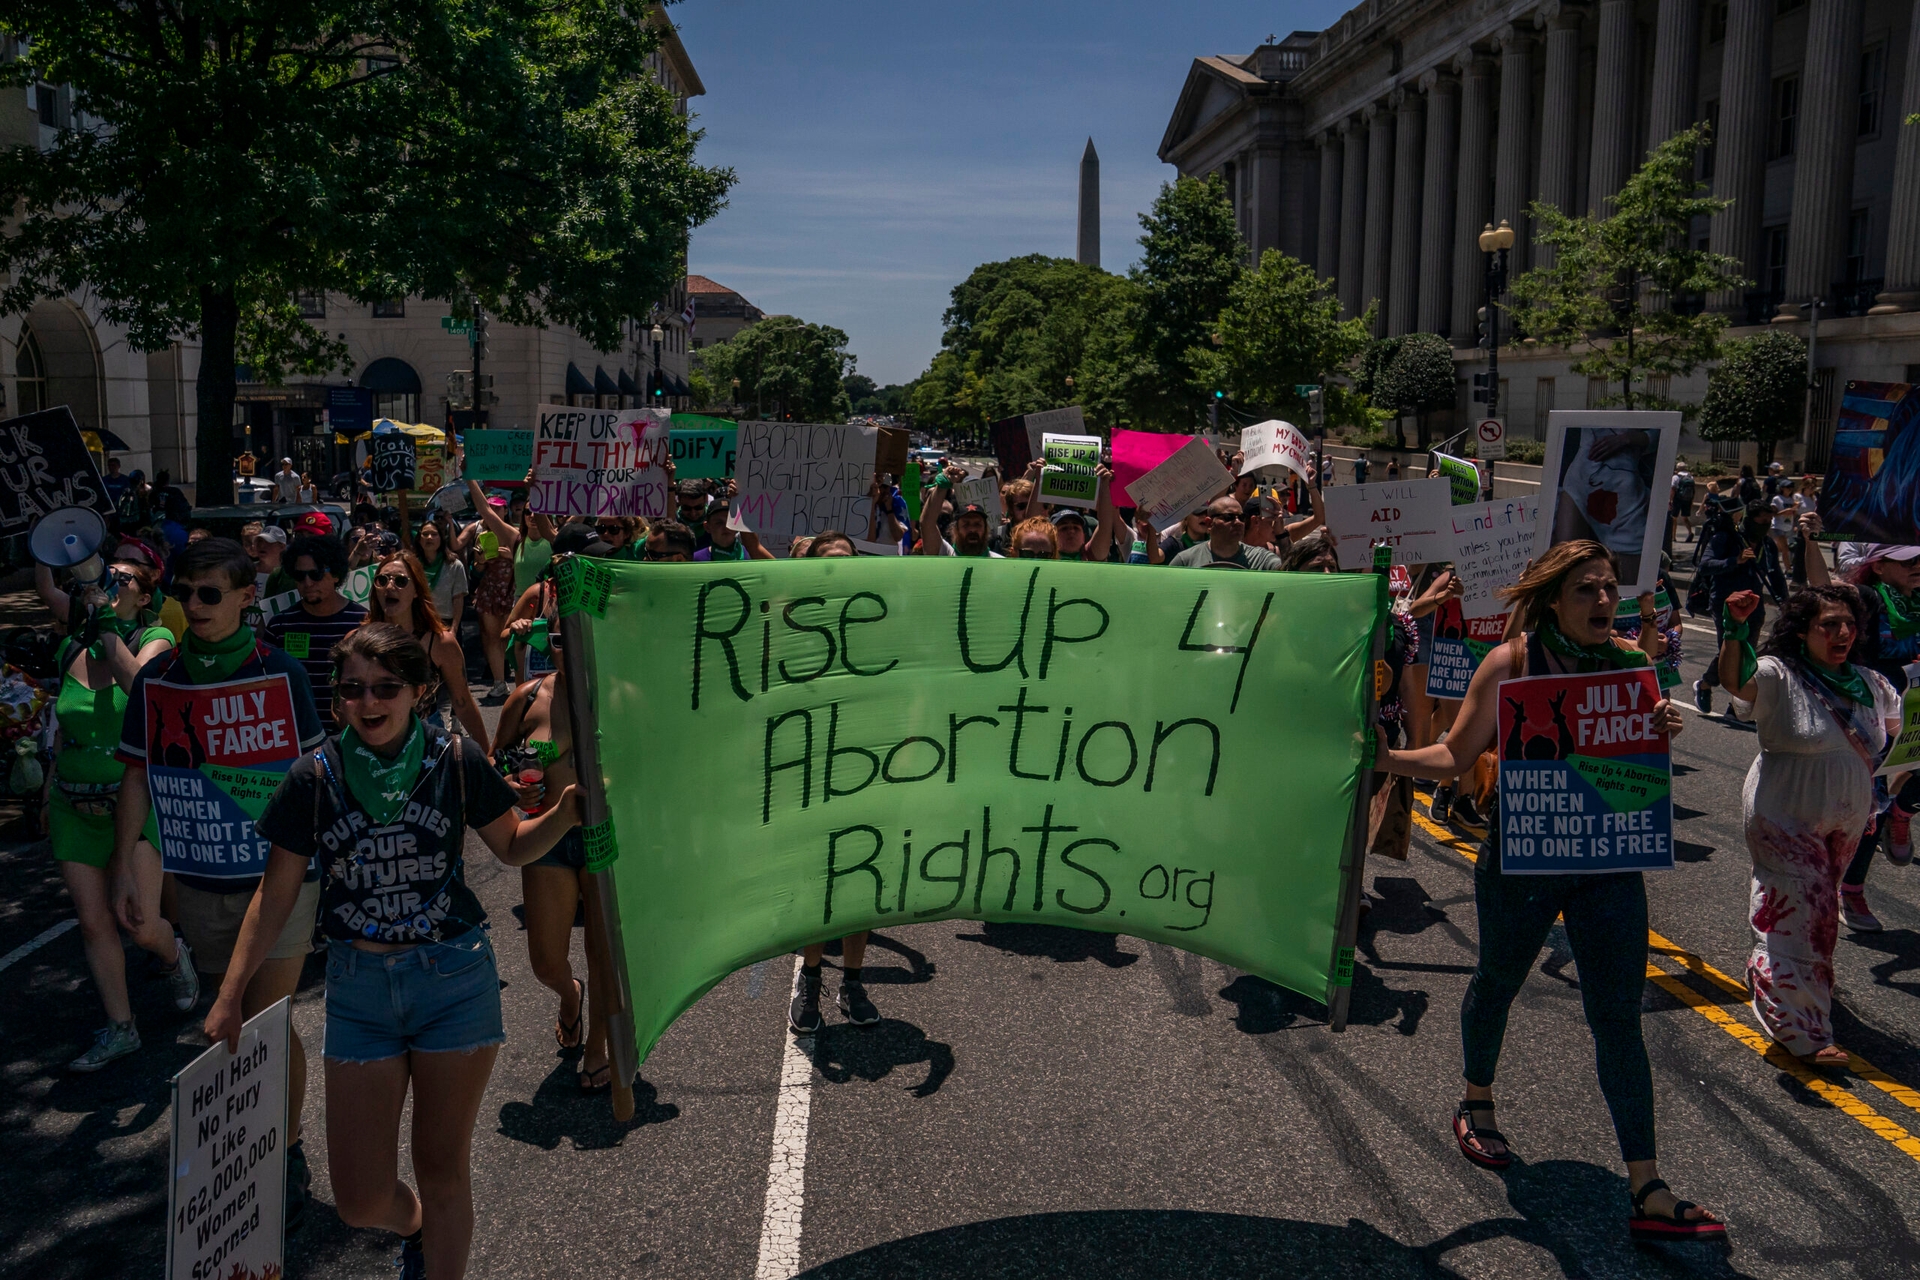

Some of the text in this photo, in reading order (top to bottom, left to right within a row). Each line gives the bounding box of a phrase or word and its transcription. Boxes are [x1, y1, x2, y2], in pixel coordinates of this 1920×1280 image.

[451, 318, 456, 327] F
[508, 432, 534, 440] CREE
[540, 413, 618, 440] KEEP UR
[1276, 428, 1290, 440] MY
[0, 424, 43, 464] CK
[670, 436, 724, 460] DiFY
[740, 424, 846, 460] ABORTION
[1048, 448, 1096, 460] RISE UP 4
[1272, 444, 1289, 454] MY
[373, 454, 400, 471] YOU
[536, 442, 631, 470] FILTHY
[374, 469, 402, 490] US
[586, 469, 606, 484] OFF
[606, 468, 636, 482] OUR
[748, 460, 828, 492] RIGHTS
[829, 462, 876, 497] ARE
[976, 480, 992, 496] NOT
[1050, 478, 1089, 493] RIGHTS!
[0, 470, 98, 528] LAWS
[530, 480, 665, 516] SILKY DRAWERS
[1359, 487, 1418, 501] I WILL
[1451, 487, 1476, 502] ONWIDE
[734, 492, 870, 536] MY RIGHTS
[1371, 508, 1401, 522] AID
[1452, 506, 1492, 534] Land
[1498, 503, 1514, 524] of
[1384, 525, 1392, 534] &
[1359, 551, 1422, 564] ATION
[1459, 541, 1490, 557] unless
[1497, 536, 1515, 552] you
[1461, 561, 1478, 572] are
[1524, 546, 1534, 556] th
[1390, 569, 1400, 580] LY
[1390, 580, 1409, 590] ARCE
[598, 574, 612, 614] OVERTURN
[1464, 592, 1479, 602] are
[1470, 620, 1504, 636] FARCE
[690, 567, 1274, 714] Rise Up 4
[1434, 642, 1464, 656] WHEN
[1431, 666, 1474, 680] ARE NOT
[1433, 654, 1470, 668] WOMEN
[1430, 677, 1467, 692] NO ONE
[204, 691, 266, 726] JULY
[1576, 682, 1642, 716] JULY
[206, 719, 289, 756] FARCE
[1578, 712, 1660, 747] FARCE
[763, 686, 1222, 824] Abortion
[212, 770, 233, 782] Rise
[236, 774, 248, 786] Up
[250, 776, 257, 786] 4
[1505, 770, 1568, 790] WHEN
[1578, 760, 1668, 786] Rise Up 4 Abortion
[152, 774, 204, 798] WHEN
[230, 787, 262, 800] Rights
[1596, 778, 1648, 797] Rights .org
[157, 796, 222, 820] WOMEN
[1506, 793, 1584, 813] WOMEN
[162, 818, 192, 840] ARE
[196, 822, 234, 842] NOT
[322, 801, 451, 852] OUR DIES
[584, 820, 611, 840] ORCED
[1506, 811, 1654, 835] ARE NOT FREE
[165, 838, 187, 860] NO
[191, 844, 226, 864] ONE
[231, 844, 251, 863] IS
[356, 832, 418, 860] OUR
[1507, 832, 1668, 858] NO ONE IS FREE
[362, 892, 422, 920] OUR
[192, 1040, 268, 1118] Hell Hath
[198, 1080, 262, 1149] No Fury
[212, 1126, 246, 1170] Like
[177, 1127, 277, 1235] 162,000,000
[197, 1182, 256, 1251] Women
